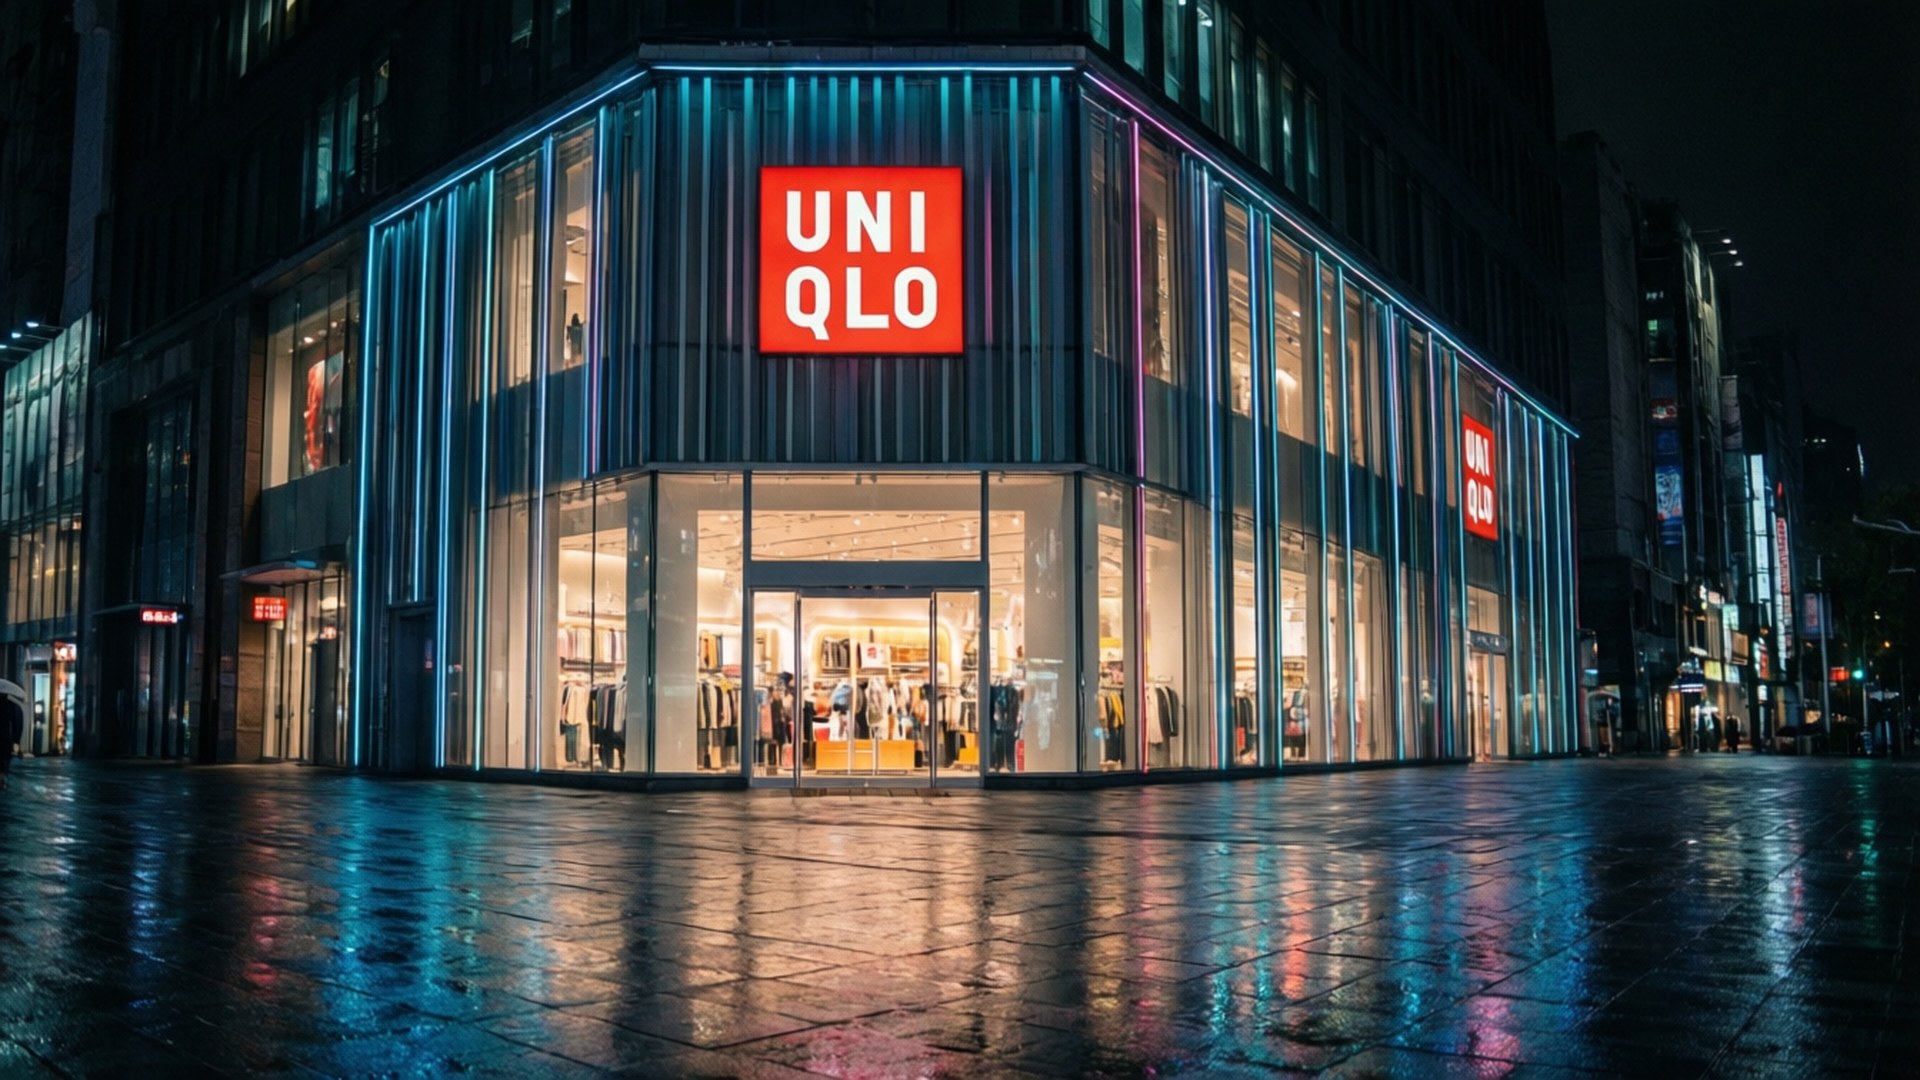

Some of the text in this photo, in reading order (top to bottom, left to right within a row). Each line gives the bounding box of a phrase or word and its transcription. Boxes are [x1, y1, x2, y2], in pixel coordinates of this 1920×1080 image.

[786, 190, 926, 253] UNI
[785, 265, 938, 341] QLO
[1465, 428, 1490, 476] UNI
[1467, 478, 1493, 524] QLO
